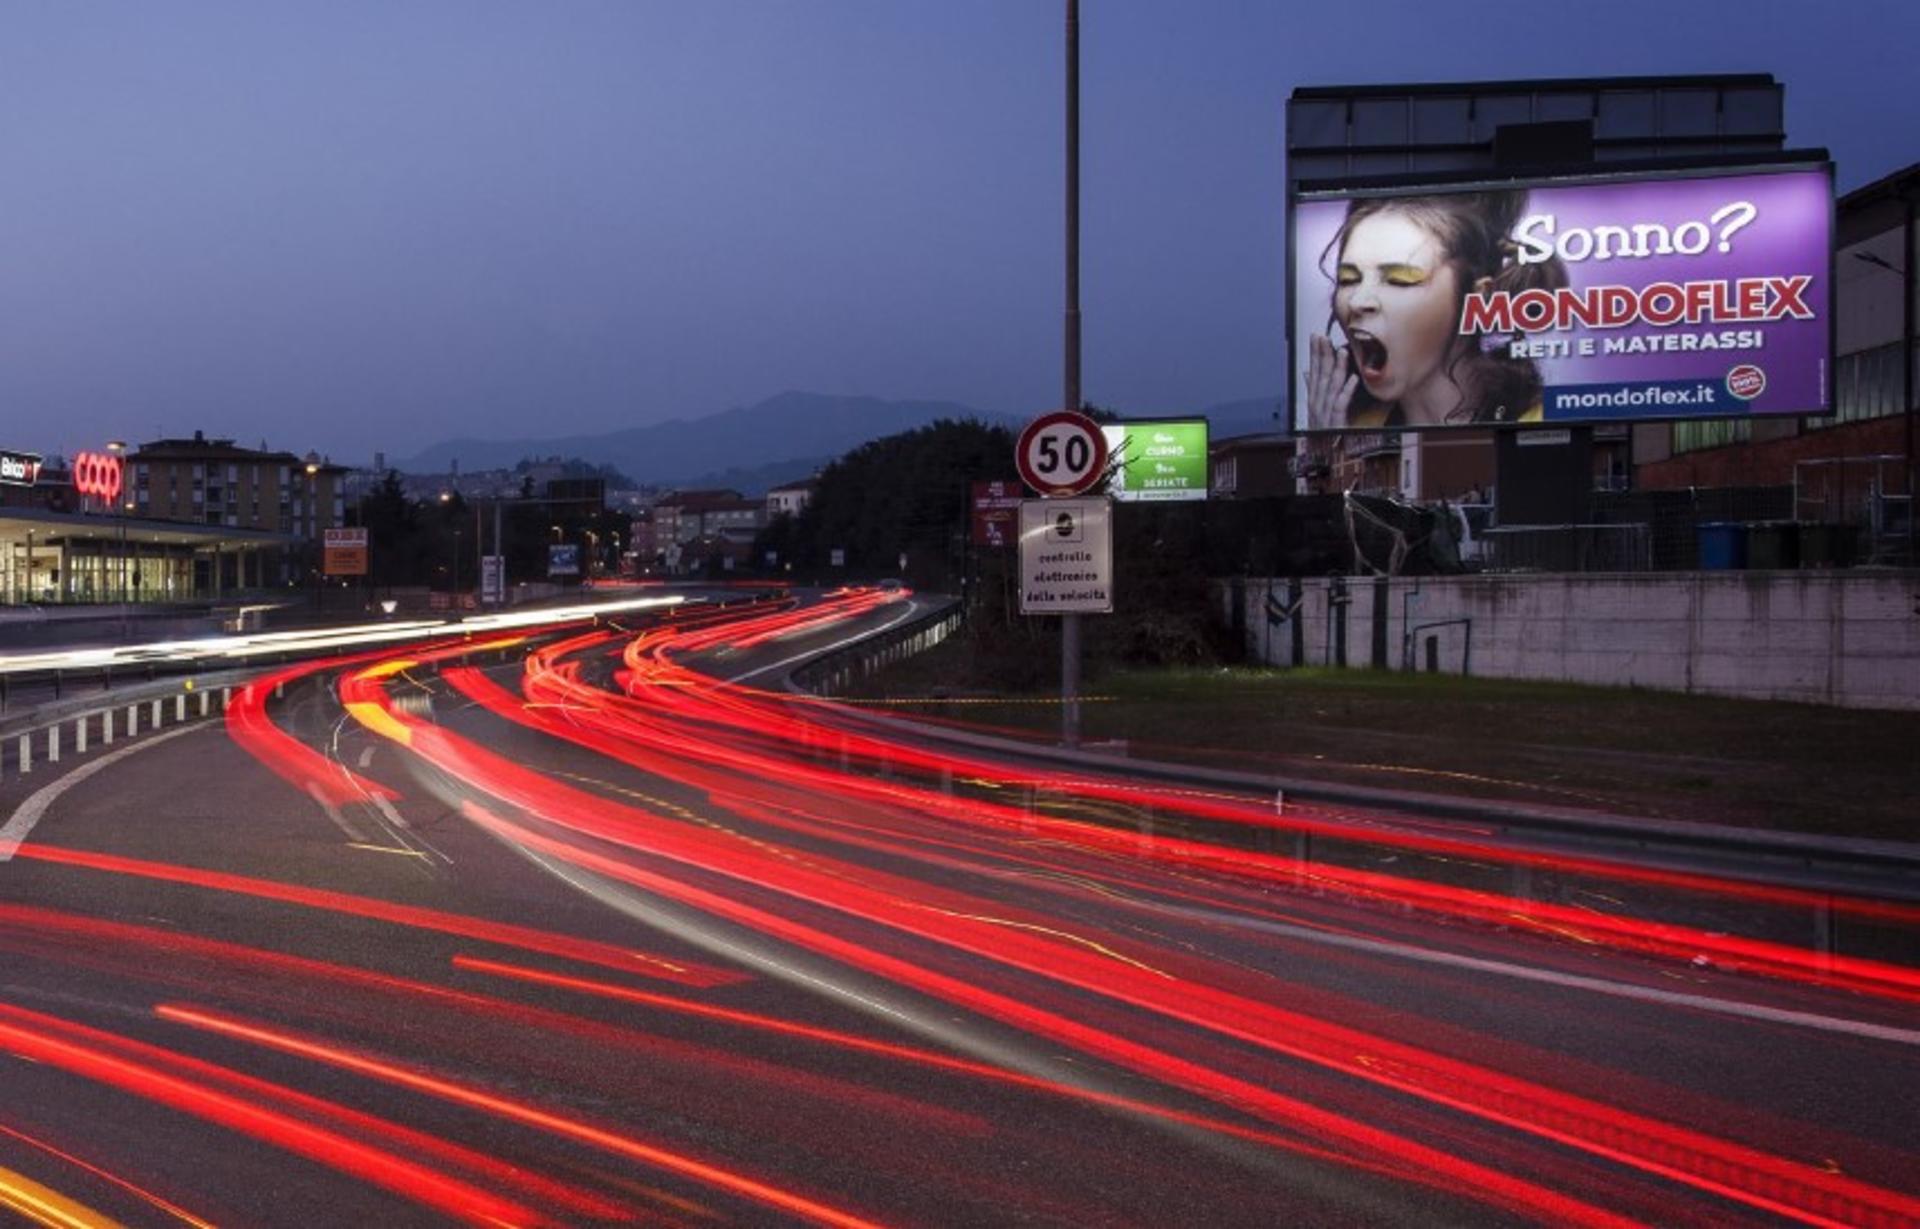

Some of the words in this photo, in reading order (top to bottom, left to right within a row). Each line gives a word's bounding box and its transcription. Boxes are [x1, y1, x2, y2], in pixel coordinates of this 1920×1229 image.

[1511, 201, 1756, 265] Sonno?
[1459, 276, 1814, 334] MONDOFLEX
[1510, 342, 1569, 359] RETI
[1578, 339, 1595, 355] E
[1603, 331, 1763, 354] MATERASSI
[1556, 386, 1715, 410] mondoflex.it
[1037, 435, 1089, 473] 50
[1038, 551, 1093, 562] controllo
[1034, 571, 1098, 582] elettronico
